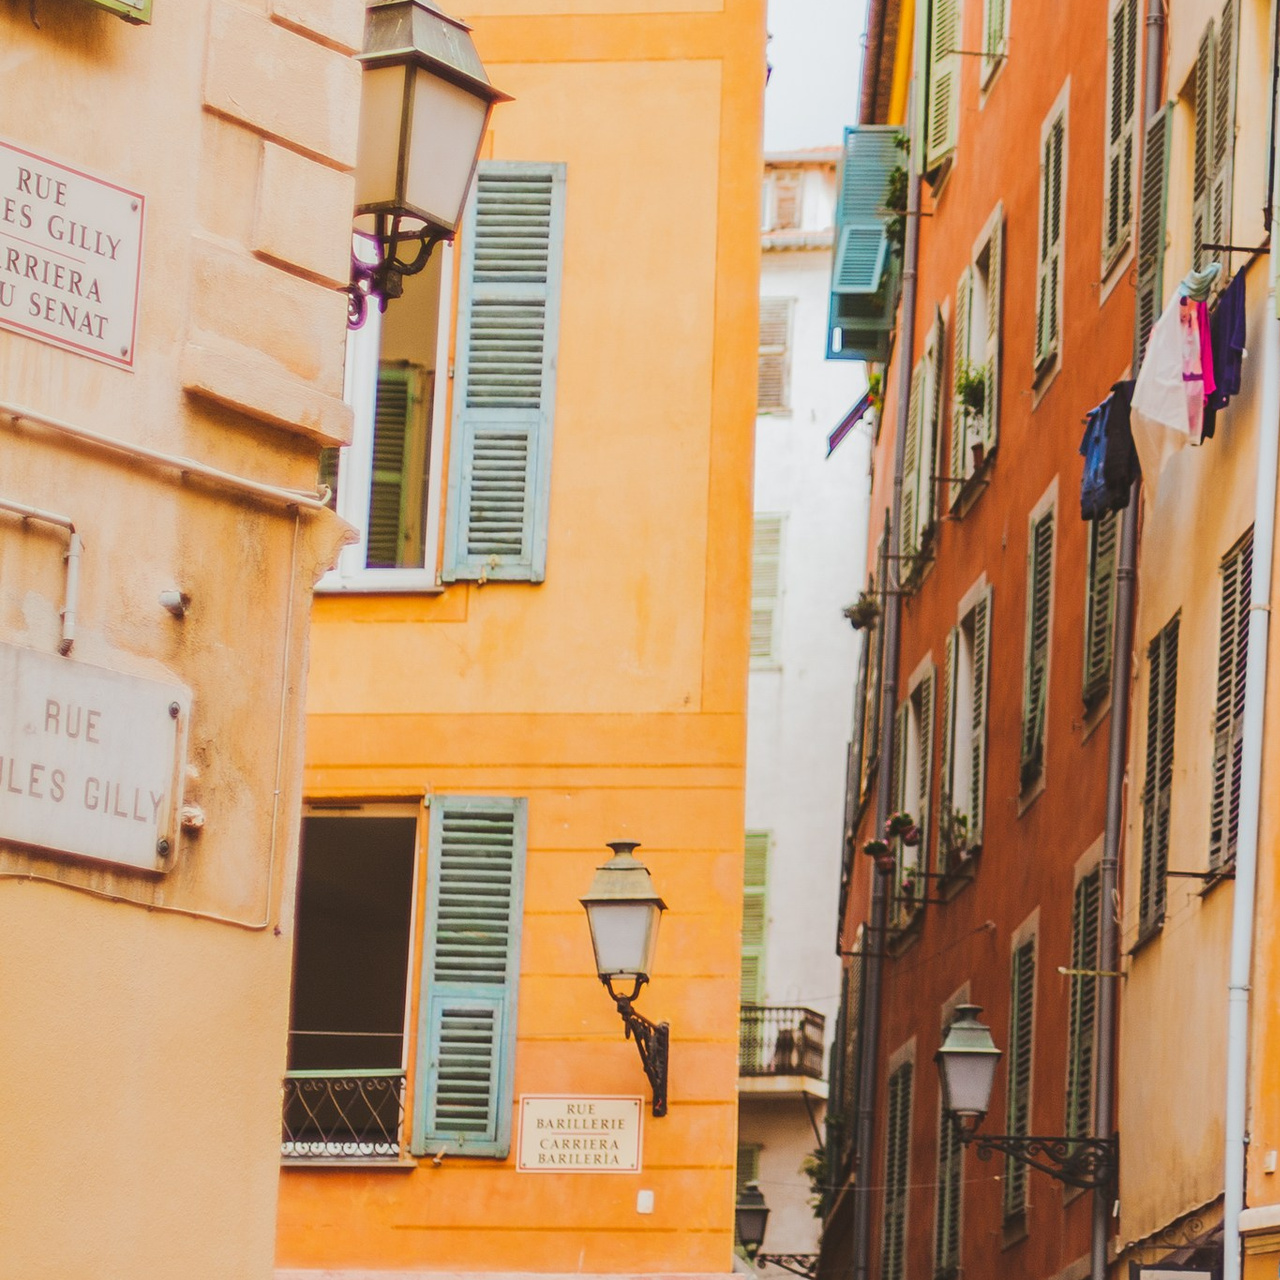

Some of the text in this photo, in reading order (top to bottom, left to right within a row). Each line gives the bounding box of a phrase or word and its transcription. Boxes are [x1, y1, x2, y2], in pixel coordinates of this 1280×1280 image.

[16, 166, 67, 207] RUE
[3, 197, 121, 261] ES GILLY
[0, 246, 102, 304] RRIERA
[28, 291, 109, 340] SENAT
[44, 698, 101, 744] RUE
[83, 776, 165, 825] GILLY
[536, 1118, 626, 1130] BARILLERIE
[566, 1103, 595, 1115] RUE
[539, 1138, 620, 1151] CARRIERA
